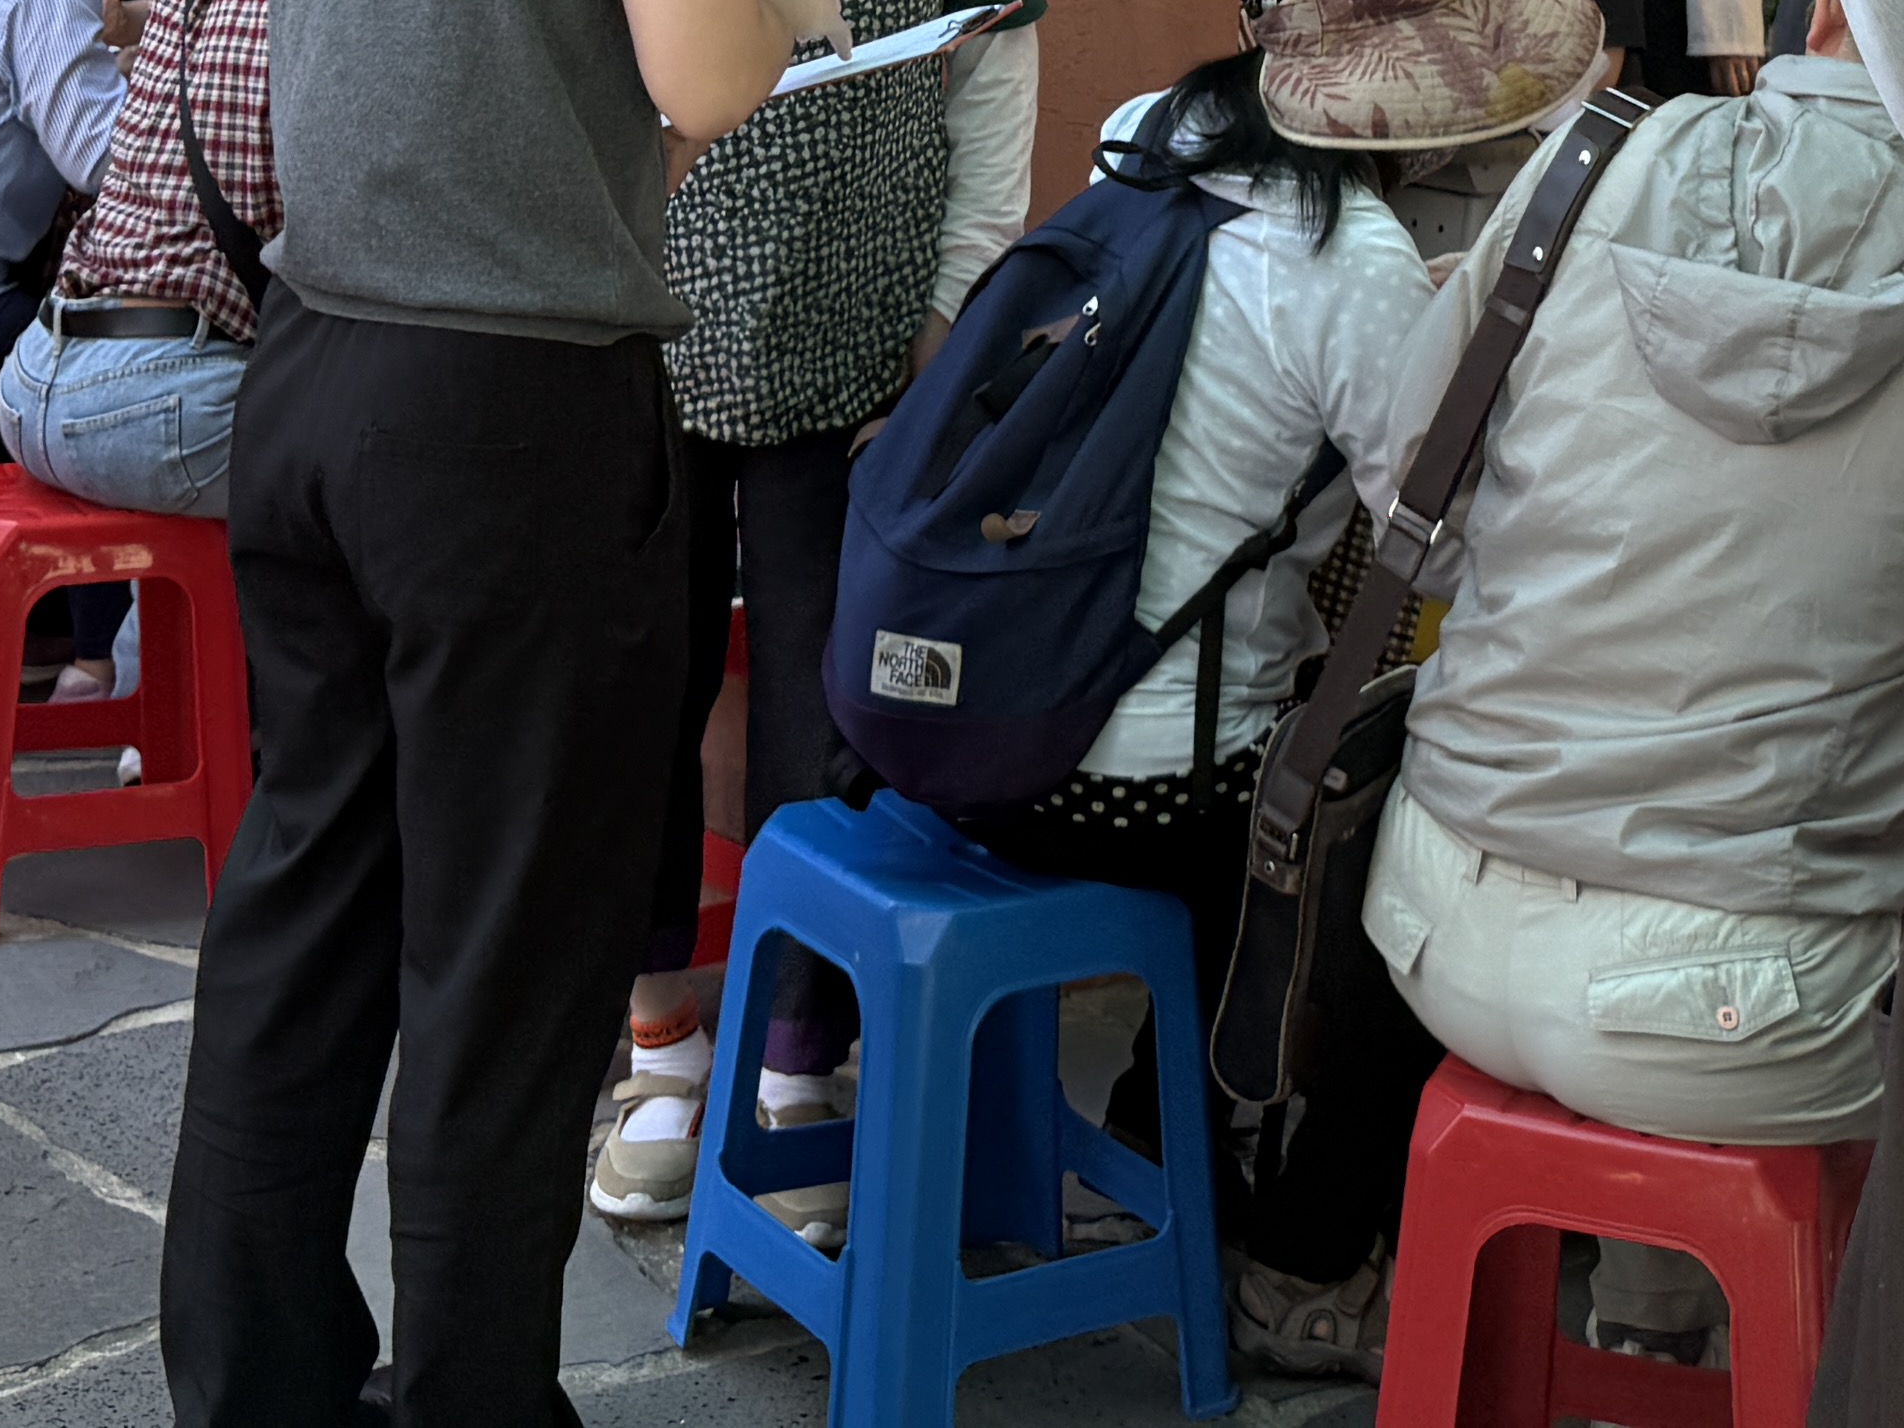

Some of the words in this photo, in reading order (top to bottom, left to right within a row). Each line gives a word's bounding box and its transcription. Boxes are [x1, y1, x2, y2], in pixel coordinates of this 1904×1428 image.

[904, 640, 927, 658] THE
[878, 649, 925, 678] NORTH
[889, 666, 923, 688] FACE
